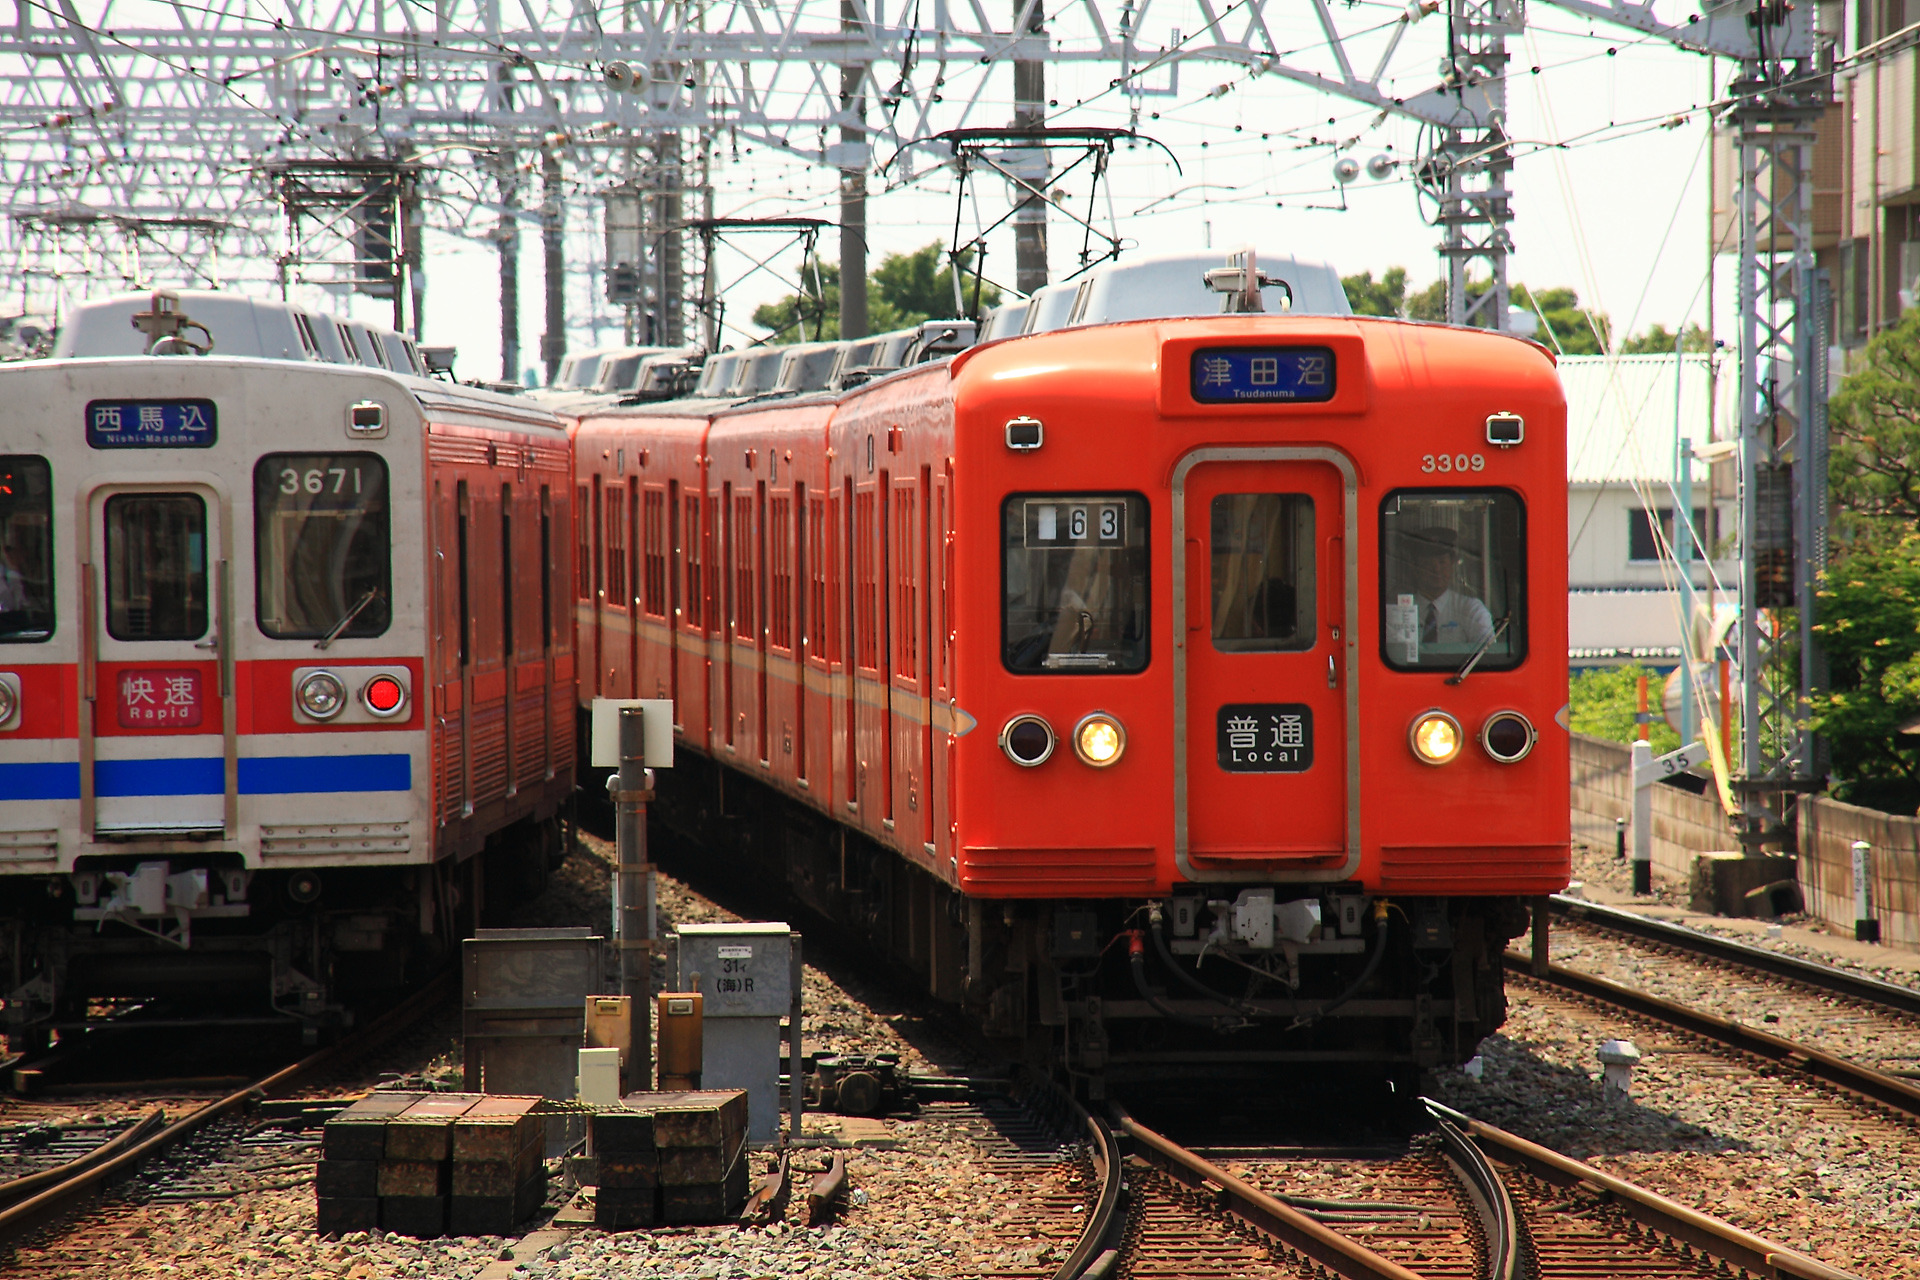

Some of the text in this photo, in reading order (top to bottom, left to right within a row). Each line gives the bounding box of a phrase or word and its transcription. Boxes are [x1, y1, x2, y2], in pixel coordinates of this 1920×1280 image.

[1202, 357, 1326, 387] 津田沼
[1233, 389, 1296, 399] Tsudanuma
[95, 405, 207, 432] 西馬込
[106, 434, 196, 443] Nishi-Magome
[1421, 453, 1486, 474] 3309
[280, 468, 361, 495] 3671
[122, 676, 195, 706] 快速
[129, 706, 190, 720] Rapid
[1226, 715, 1305, 748] 普通
[1232, 748, 1298, 762] Local
[1662, 753, 1689, 774] 35
